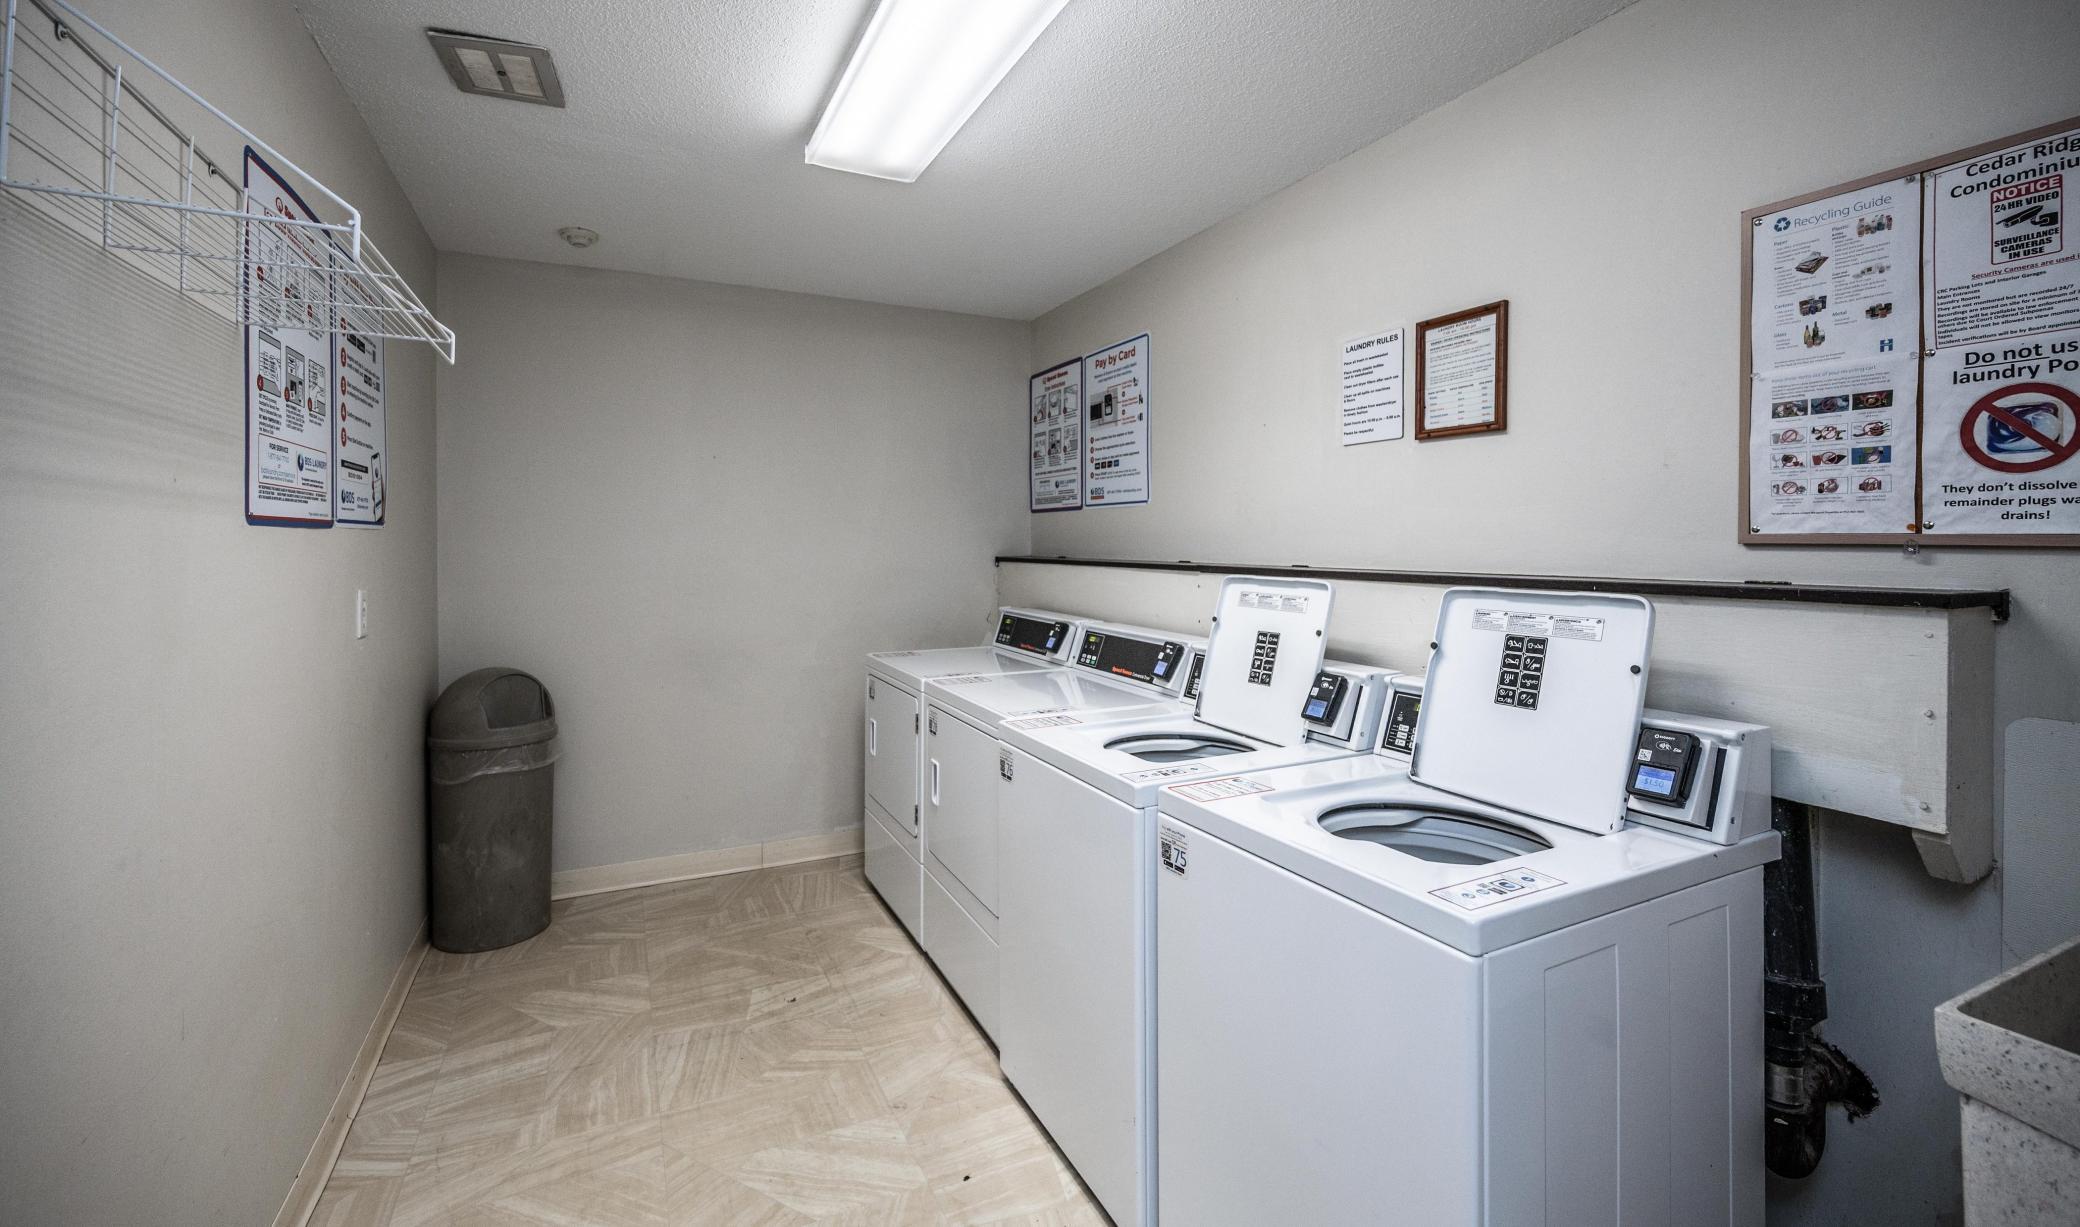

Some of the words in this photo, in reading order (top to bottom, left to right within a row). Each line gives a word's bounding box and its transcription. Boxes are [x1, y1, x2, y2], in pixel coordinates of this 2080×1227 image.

[1966, 152, 2026, 177] Cedar
[1950, 156, 2080, 198] Condominiu
[1992, 175, 2060, 202] NOTICE
[2025, 191, 2059, 205] VIDEO
[1794, 207, 1850, 229] Recycling
[1853, 194, 1892, 211] Guide
[1994, 227, 2060, 247] SURVEILLANCE
[2000, 236, 2053, 253] CAMERAS
[2008, 251, 2020, 259] IN
[2023, 246, 2045, 256] USE
[1971, 269, 2002, 280] Security
[2004, 261, 2039, 272] Cameras
[2041, 259, 2054, 267] are
[2056, 253, 2075, 264] used
[2022, 270, 2047, 278] Garages
[1345, 340, 1375, 354] LAUNDRY
[1376, 333, 1399, 346] RULES
[1095, 359, 1106, 370] Pay
[1108, 353, 1117, 366] by
[1119, 345, 1136, 361] Card
[1965, 352, 1995, 366] Do
[2003, 343, 2043, 361] not
[1953, 364, 2041, 384] laundry
[1942, 484, 1974, 495] They
[1978, 481, 2015, 492] don't
[2018, 480, 2078, 490] dissolve
[1944, 496, 2015, 507] remainder
[2018, 496, 2057, 507] plugs
[2000, 510, 2051, 520] drains!
[1174, 847, 1187, 868] 75
